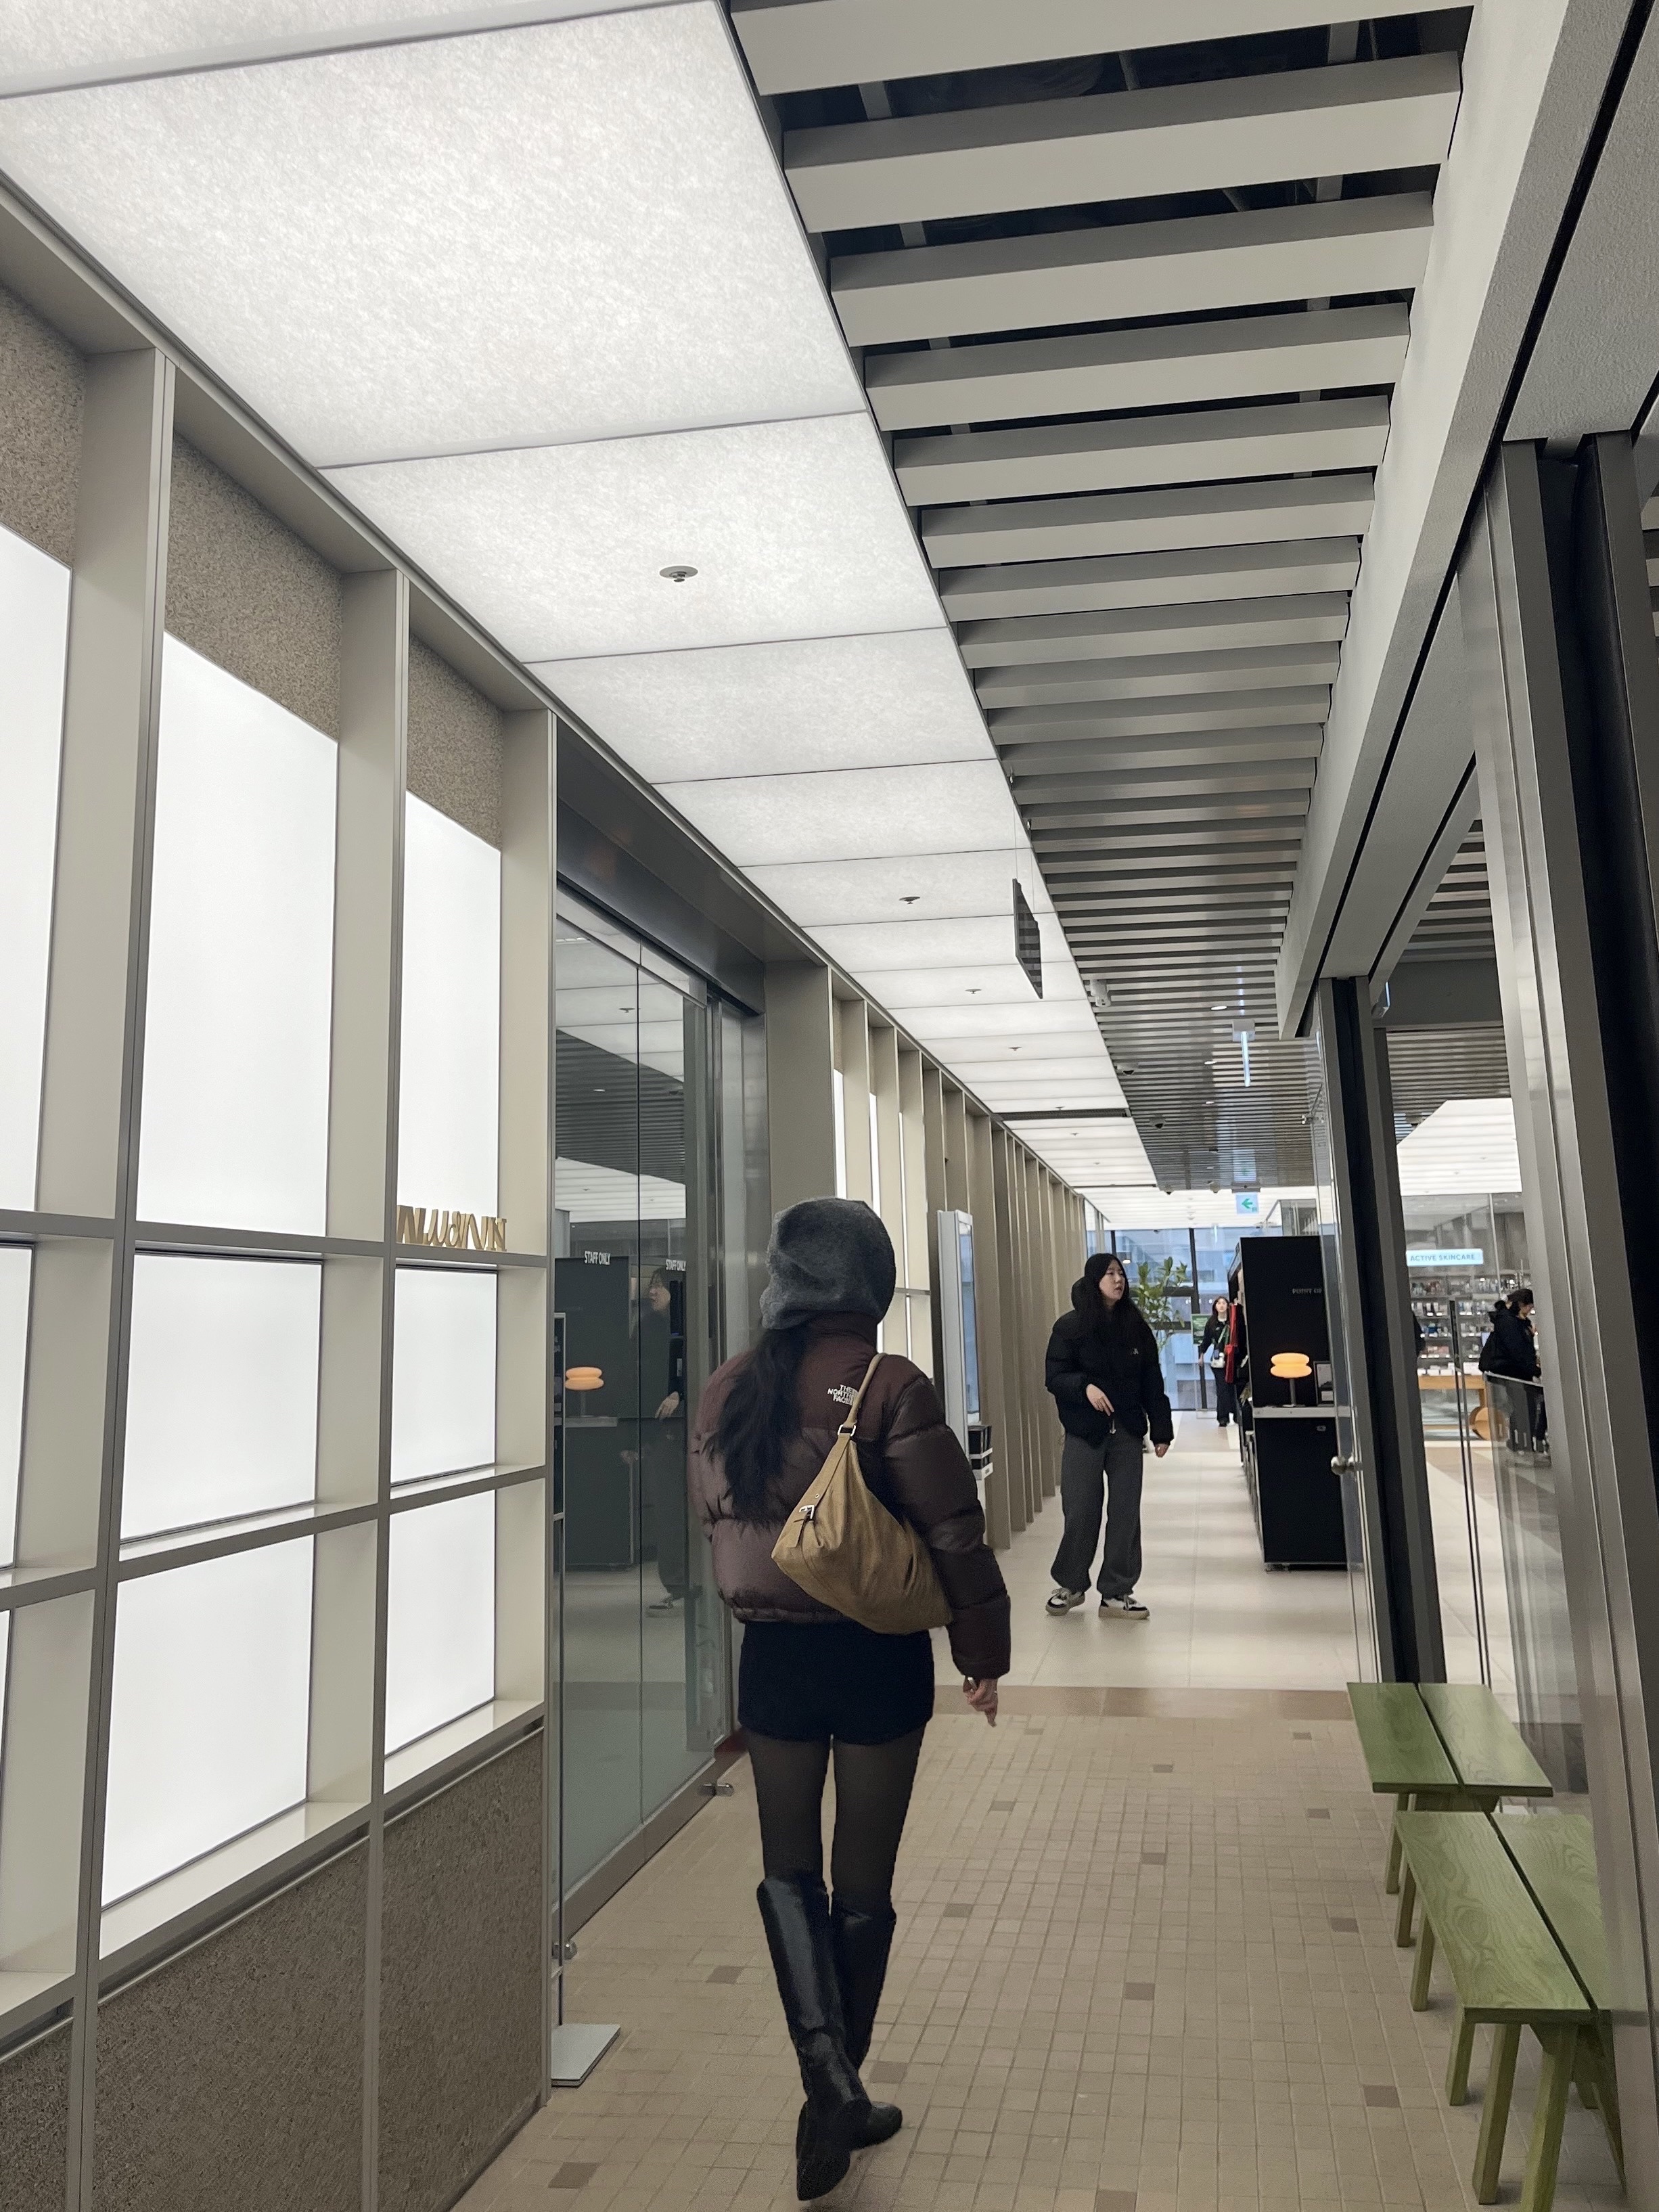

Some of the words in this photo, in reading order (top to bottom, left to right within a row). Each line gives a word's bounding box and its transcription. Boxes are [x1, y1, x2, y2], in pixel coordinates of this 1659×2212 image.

[584, 1250, 598, 1265] STAFF
[599, 1252, 611, 1265] ONLY
[827, 1388, 853, 1399] NORTH
[840, 1384, 853, 1394] THE
[833, 1395, 853, 1405] FACE
